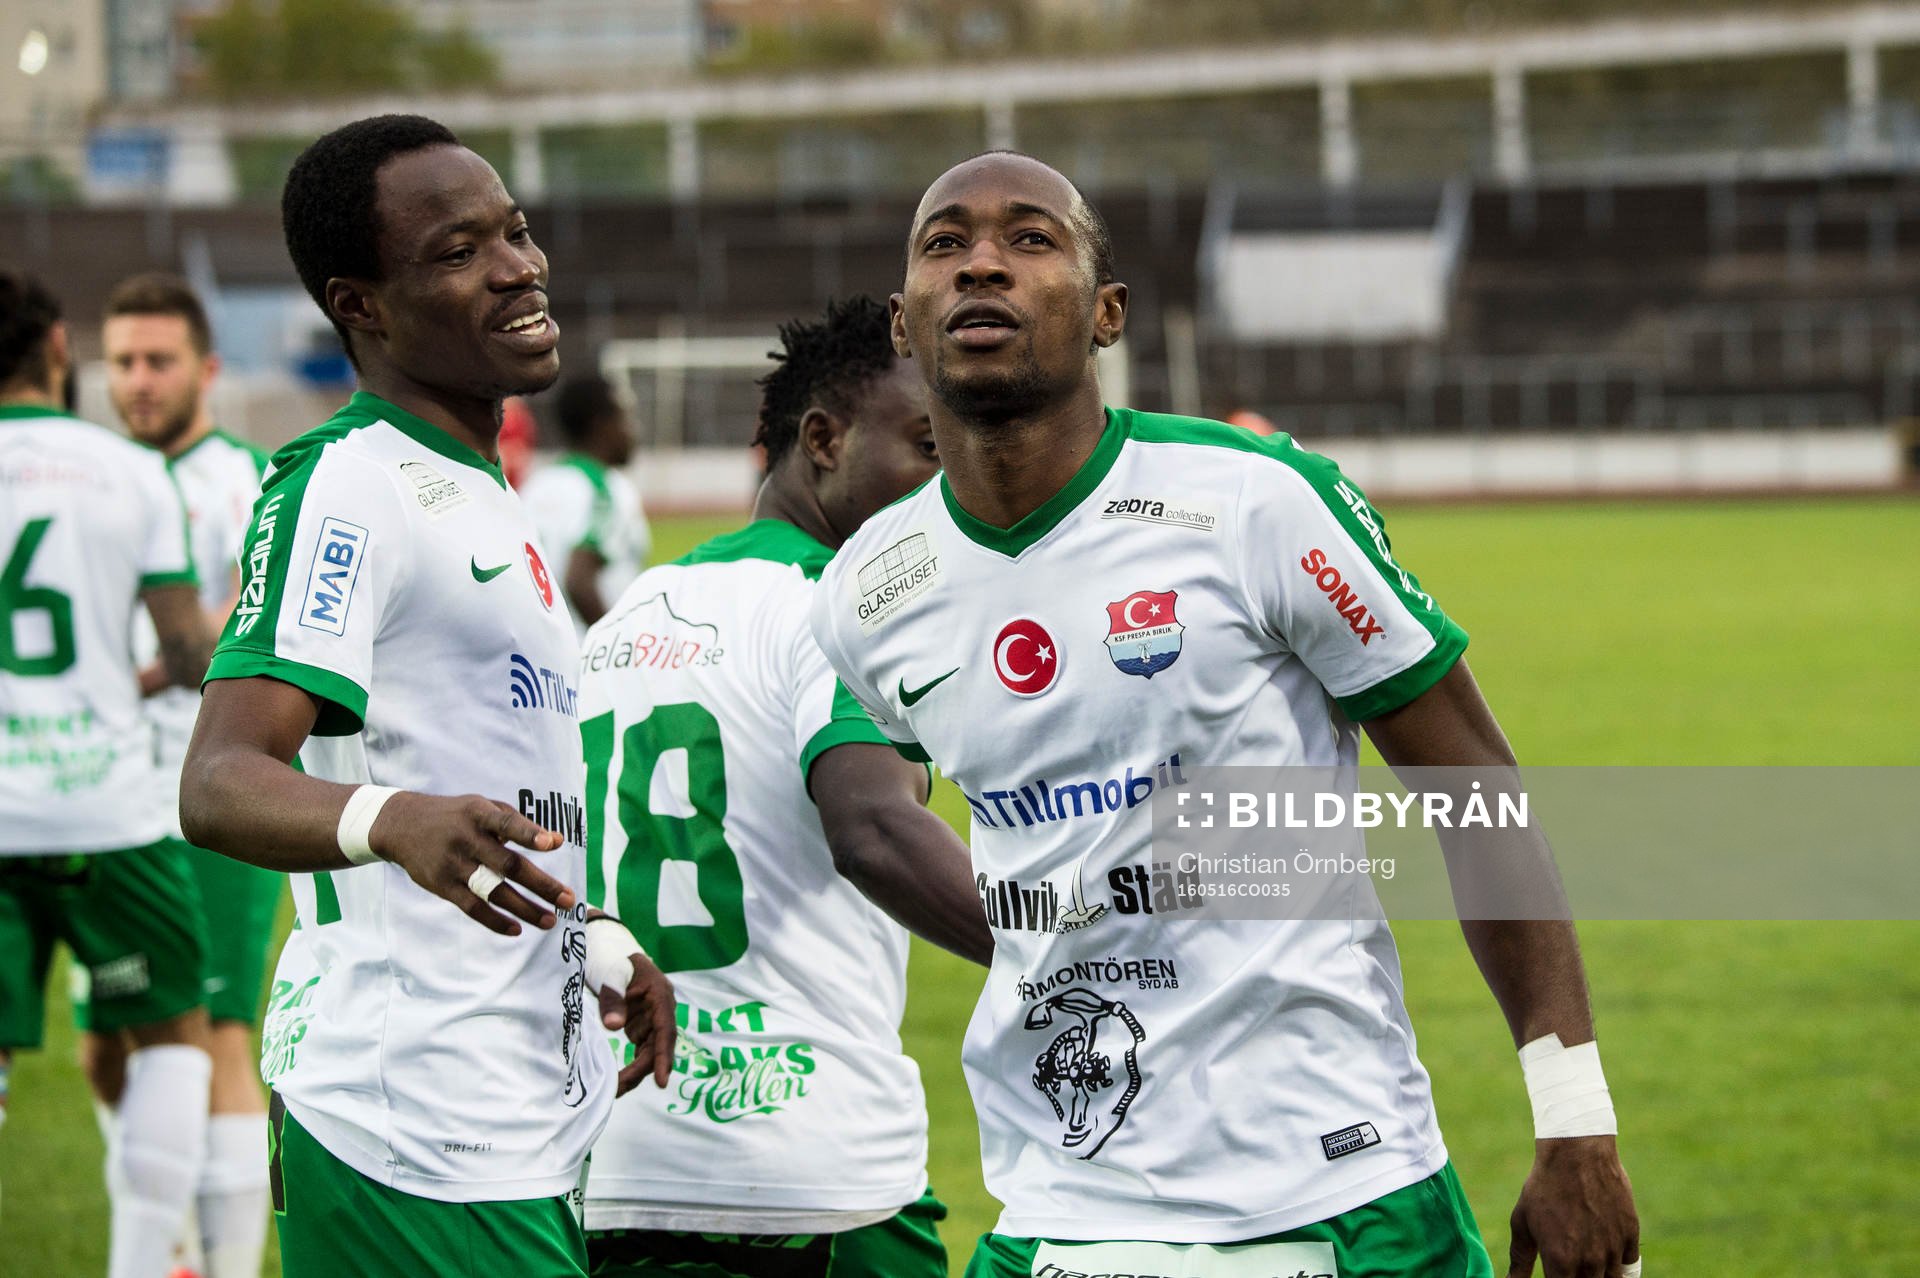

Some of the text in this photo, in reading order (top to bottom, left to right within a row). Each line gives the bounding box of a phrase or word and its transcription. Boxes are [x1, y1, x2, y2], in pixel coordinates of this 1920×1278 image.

[1103, 498, 1215, 525] zebra collection
[234, 493, 284, 637] stadium
[310, 528, 358, 624] MABI
[858, 556, 938, 620] GLASHUSET
[0, 516, 76, 677] 6
[1300, 548, 1385, 647] SONAX
[1127, 630, 1151, 640] PRESPA
[1152, 626, 1172, 634] BIRLIK
[579, 701, 749, 973] 18
[1107, 858, 1204, 915] Städ
[1015, 957, 1177, 1001] RMONTÖREN
[1138, 978, 1179, 990] SYD AB
[667, 1055, 810, 1124] Hallen
[443, 1142, 494, 1153] DRI-FIT
[1326, 1129, 1360, 1146] AUTHENTIC
[1329, 1138, 1363, 1155] FOOTBALL
